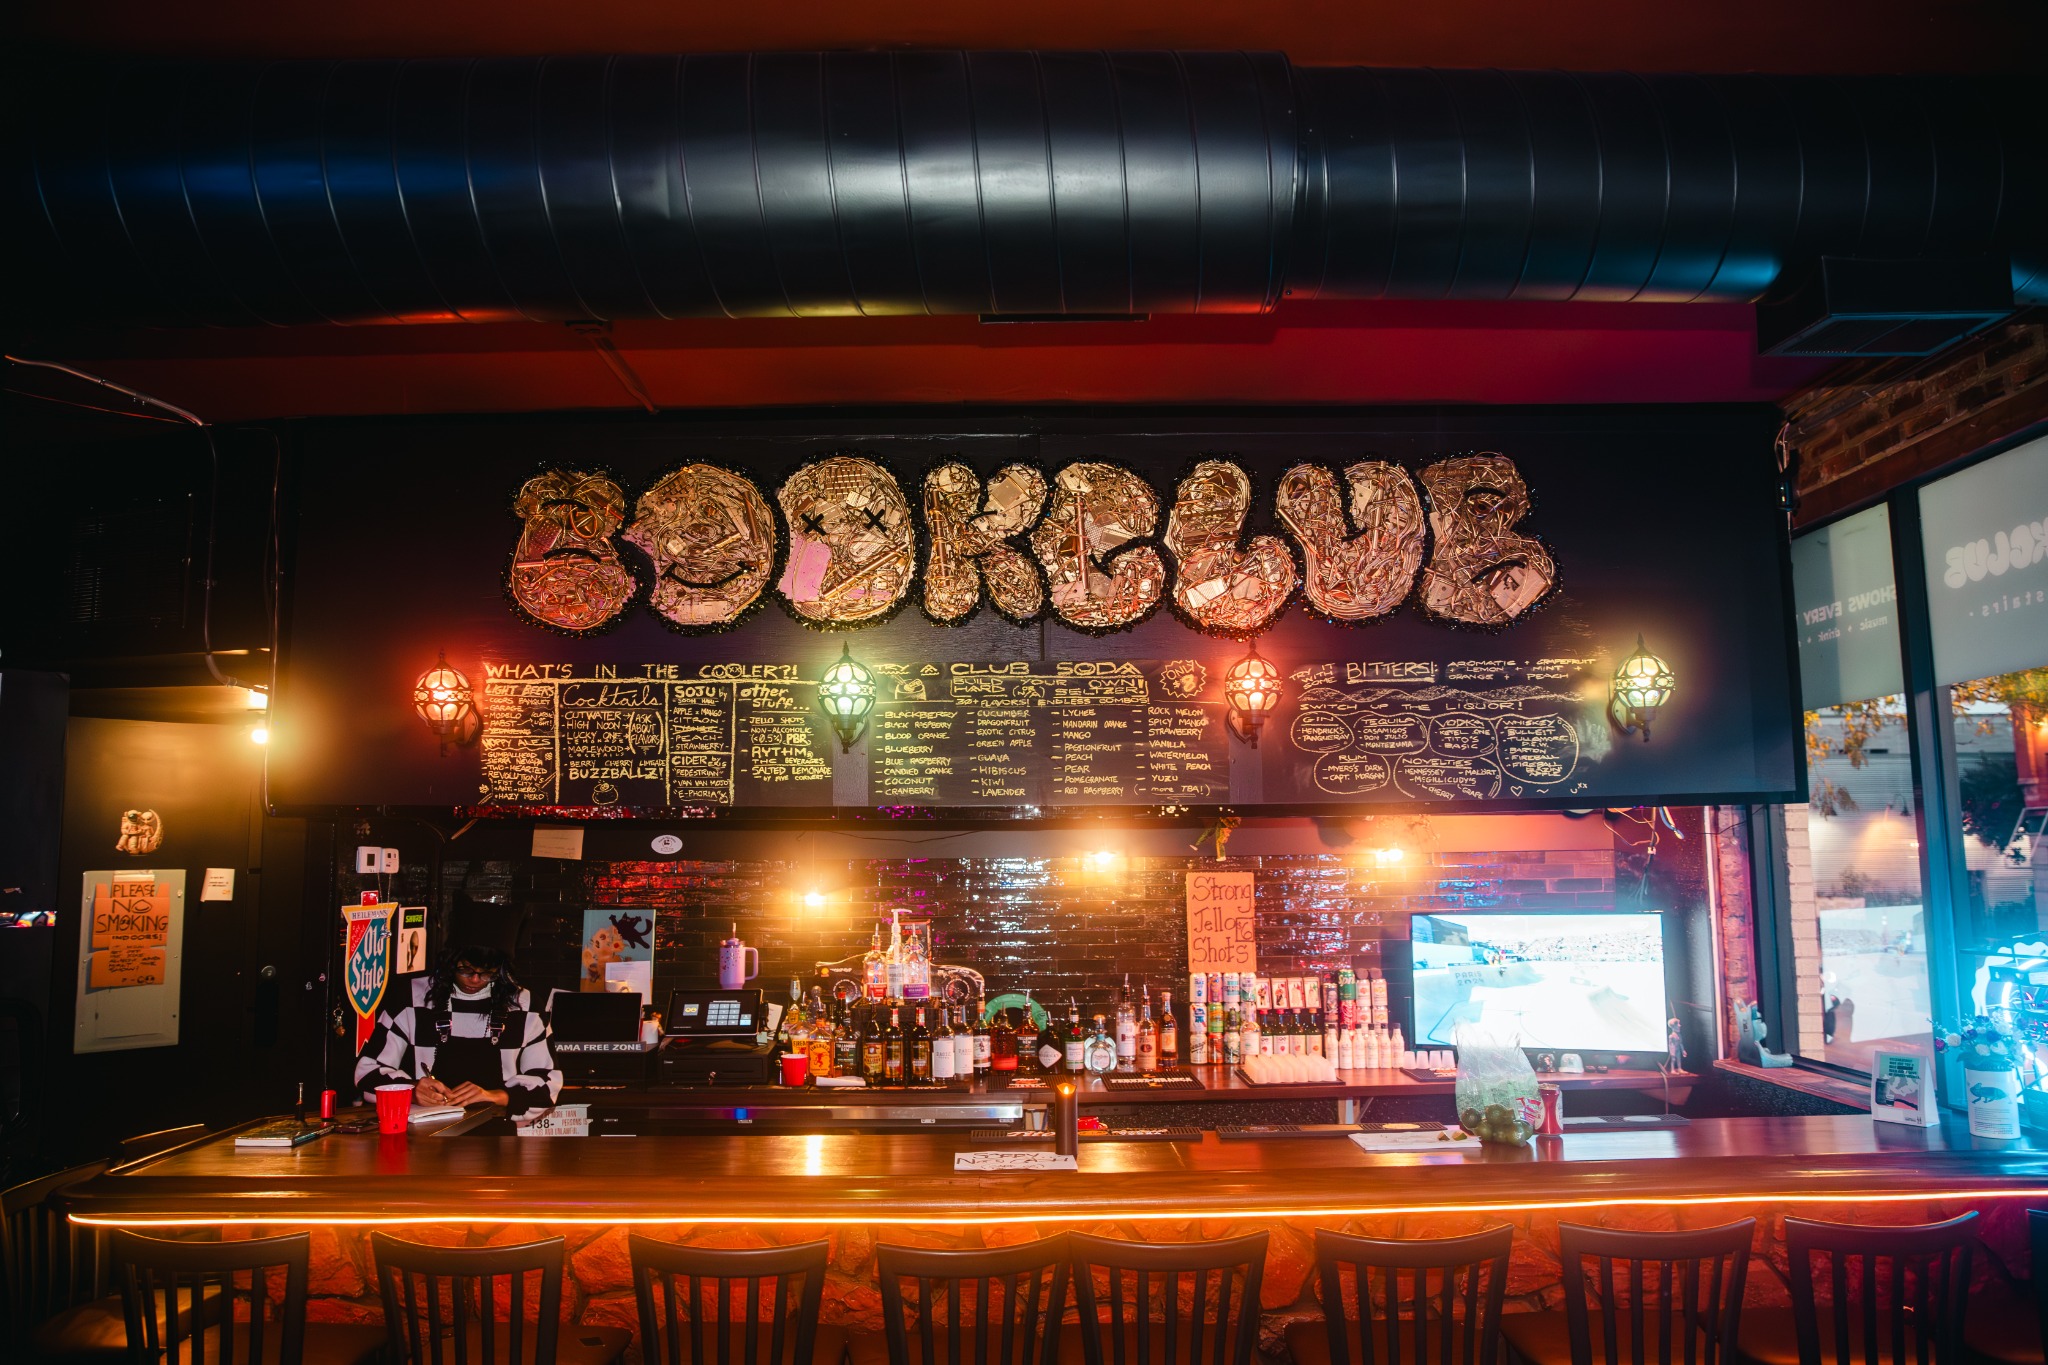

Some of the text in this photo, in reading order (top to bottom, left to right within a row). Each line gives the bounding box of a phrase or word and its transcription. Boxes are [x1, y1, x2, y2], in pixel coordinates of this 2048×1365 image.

[483, 662, 799, 680] WHAT'S IN THE COOLER?!
[872, 661, 1143, 676] TRY CLUB SODA
[1166, 659, 1195, 680] ONLY
[1288, 662, 1336, 681] TRY IT
[1466, 665, 1504, 673] LEMON
[1301, 670, 1334, 683] WITH
[1527, 672, 1569, 681] PEACH
[952, 678, 1068, 687] BUILD YOUR
[1172, 673, 1197, 693] $8
[1302, 676, 1337, 690] SOME
[485, 684, 555, 698] LIGHT BEERS
[674, 685, 716, 699] SOJU
[953, 684, 1006, 693] HARD
[562, 683, 663, 708] Cocktails
[980, 698, 1092, 708] FLAVORS! ENDLESS
[1401, 703, 1432, 711] THE
[1445, 701, 1523, 711] LIQUOR!
[489, 711, 522, 719] MODELO
[564, 710, 622, 721] CUTWATER
[672, 706, 693, 716] APPLE
[884, 711, 959, 719] BLACKBERRY
[976, 709, 1032, 718] CUCUMBER
[1062, 707, 1097, 717] LYCHEE
[1147, 706, 1204, 717] ROCK MELON
[489, 719, 518, 727] PABST
[635, 713, 652, 724] ASK
[673, 716, 719, 724] CITRON
[749, 716, 806, 725] JELLO SHOTS
[977, 719, 1031, 727] DRAGONFRUIT
[1147, 717, 1206, 728] SPICY MANGO
[1360, 717, 1417, 726] TEQUILA
[1434, 719, 1485, 728] VODKA
[566, 719, 621, 730] HIGH NOON
[631, 723, 657, 734] ABOUT
[884, 721, 953, 730] BLACK RASPBERRY
[1062, 720, 1128, 729] MANDARIN ORANGE
[566, 731, 623, 741] LUCKY ONE
[884, 732, 951, 740] BLOOD ORANGE
[975, 728, 1036, 737] EXOTIC CITRUS
[1062, 731, 1092, 740] MANGO
[1148, 727, 1203, 741] STRAWBERRY
[1362, 727, 1408, 735] CASAMIGOS
[517, 738, 551, 747] ALES
[675, 734, 717, 742] PEACH
[785, 733, 812, 745] PBR
[1301, 733, 1350, 742] TANQUERAY
[675, 742, 725, 750] STRAWBERRY
[976, 739, 1033, 748] GREEN APPLE
[1064, 743, 1122, 752] PASSIONFRUIT
[1149, 740, 1186, 749] VANILLA
[1365, 741, 1415, 749] MONTEZUMA
[1444, 742, 1479, 750] BASIC
[567, 745, 624, 754] MAPLEWOOD
[884, 745, 934, 754] BLUEBERRY
[1509, 747, 1547, 755] BARTON
[671, 755, 708, 766] CIDER
[977, 753, 1011, 763] GUAVA
[1065, 753, 1093, 762] PEACH
[1149, 751, 1209, 762] WATERMELON
[884, 757, 952, 767] BLUE RASPBERRY
[1150, 762, 1212, 772] WHITE PEACH
[1402, 758, 1473, 767] NOVELTIES
[751, 766, 833, 776] SALTED LEMONADE
[883, 766, 954, 776] CANDIED ORANGE
[979, 765, 1027, 776] HIBISCUS
[1064, 765, 1091, 774] PEAR
[884, 776, 935, 786] COCONUT
[1064, 775, 1119, 784] POMEGRANATE
[1151, 774, 1179, 783] YUZU
[1355, 772, 1386, 781] MORGAN
[980, 777, 1005, 787] KIWI
[884, 787, 935, 796] CRANBERRY
[981, 787, 1026, 797] LAVENDER
[1064, 786, 1124, 797] RED RASPBERRY
[113, 884, 155, 898] PLEASE
[1192, 875, 1252, 914] Strong
[111, 899, 153, 915] NO
[95, 913, 169, 934] SMOKING
[1193, 906, 1236, 934] Jello
[363, 924, 386, 960] Old
[1192, 936, 1249, 964] Shots
[350, 951, 384, 1006] Style
[1455, 971, 1482, 979] PARIS
[1457, 978, 1484, 986] 2024
[583, 1043, 610, 1052] FREE
[612, 1043, 642, 1052] ZONE
